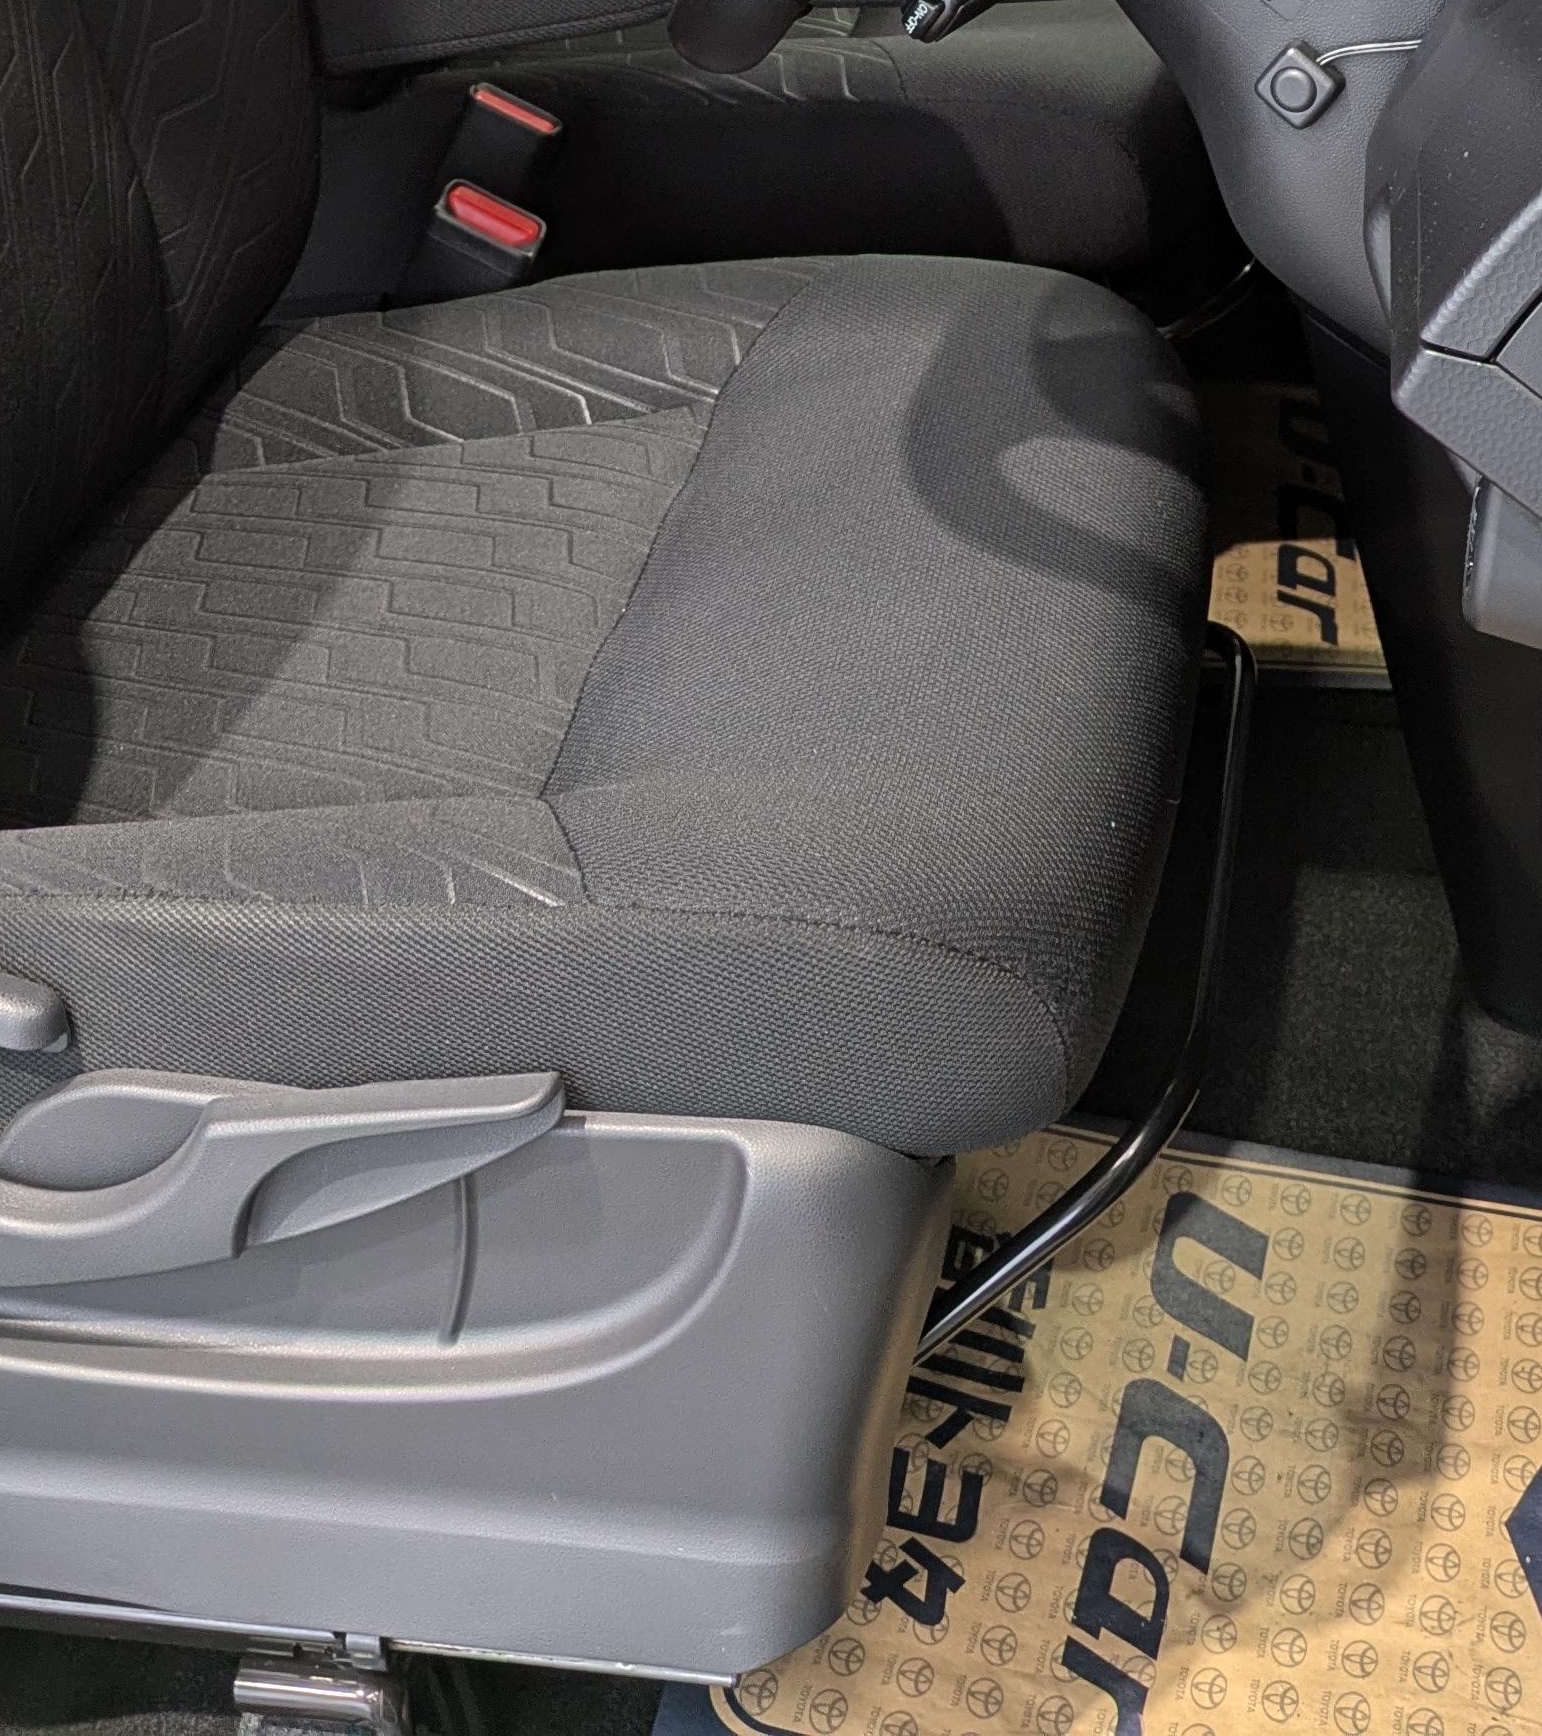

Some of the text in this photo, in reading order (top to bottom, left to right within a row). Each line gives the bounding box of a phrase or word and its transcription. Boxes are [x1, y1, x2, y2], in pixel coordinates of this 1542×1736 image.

[905, 3, 928, 35] ON-OFF
[1494, 1405, 1505, 1436] TOYOTA
[1061, 1192, 1272, 1736] U-Car
[1489, 1454, 1501, 1485] TOYOTA
[1485, 1506, 1497, 1537] TOYOTA
[1342, 1527, 1355, 1563] TOYOTA
[1411, 1540, 1423, 1574] TOYOTA
[1049, 1586, 1064, 1619] TOYOTA
[1334, 1582, 1347, 1618] TOYOTA
[1405, 1593, 1417, 1628] TOYOTA
[965, 1622, 982, 1655] TOYOTA
[1257, 1627, 1269, 1658] TOYOTA
[1327, 1639, 1340, 1672] TOYOTA
[1036, 1639, 1051, 1673] TOYOTA
[1398, 1650, 1411, 1683] TOYOTA
[1176, 1666, 1190, 1700] TOYOTA
[1247, 1679, 1259, 1713] TOYOTA
[1470, 1663, 1483, 1701] TOYOTA
[1020, 1694, 1037, 1729] TOYOTA
[1319, 1690, 1333, 1727] TOYOTA
